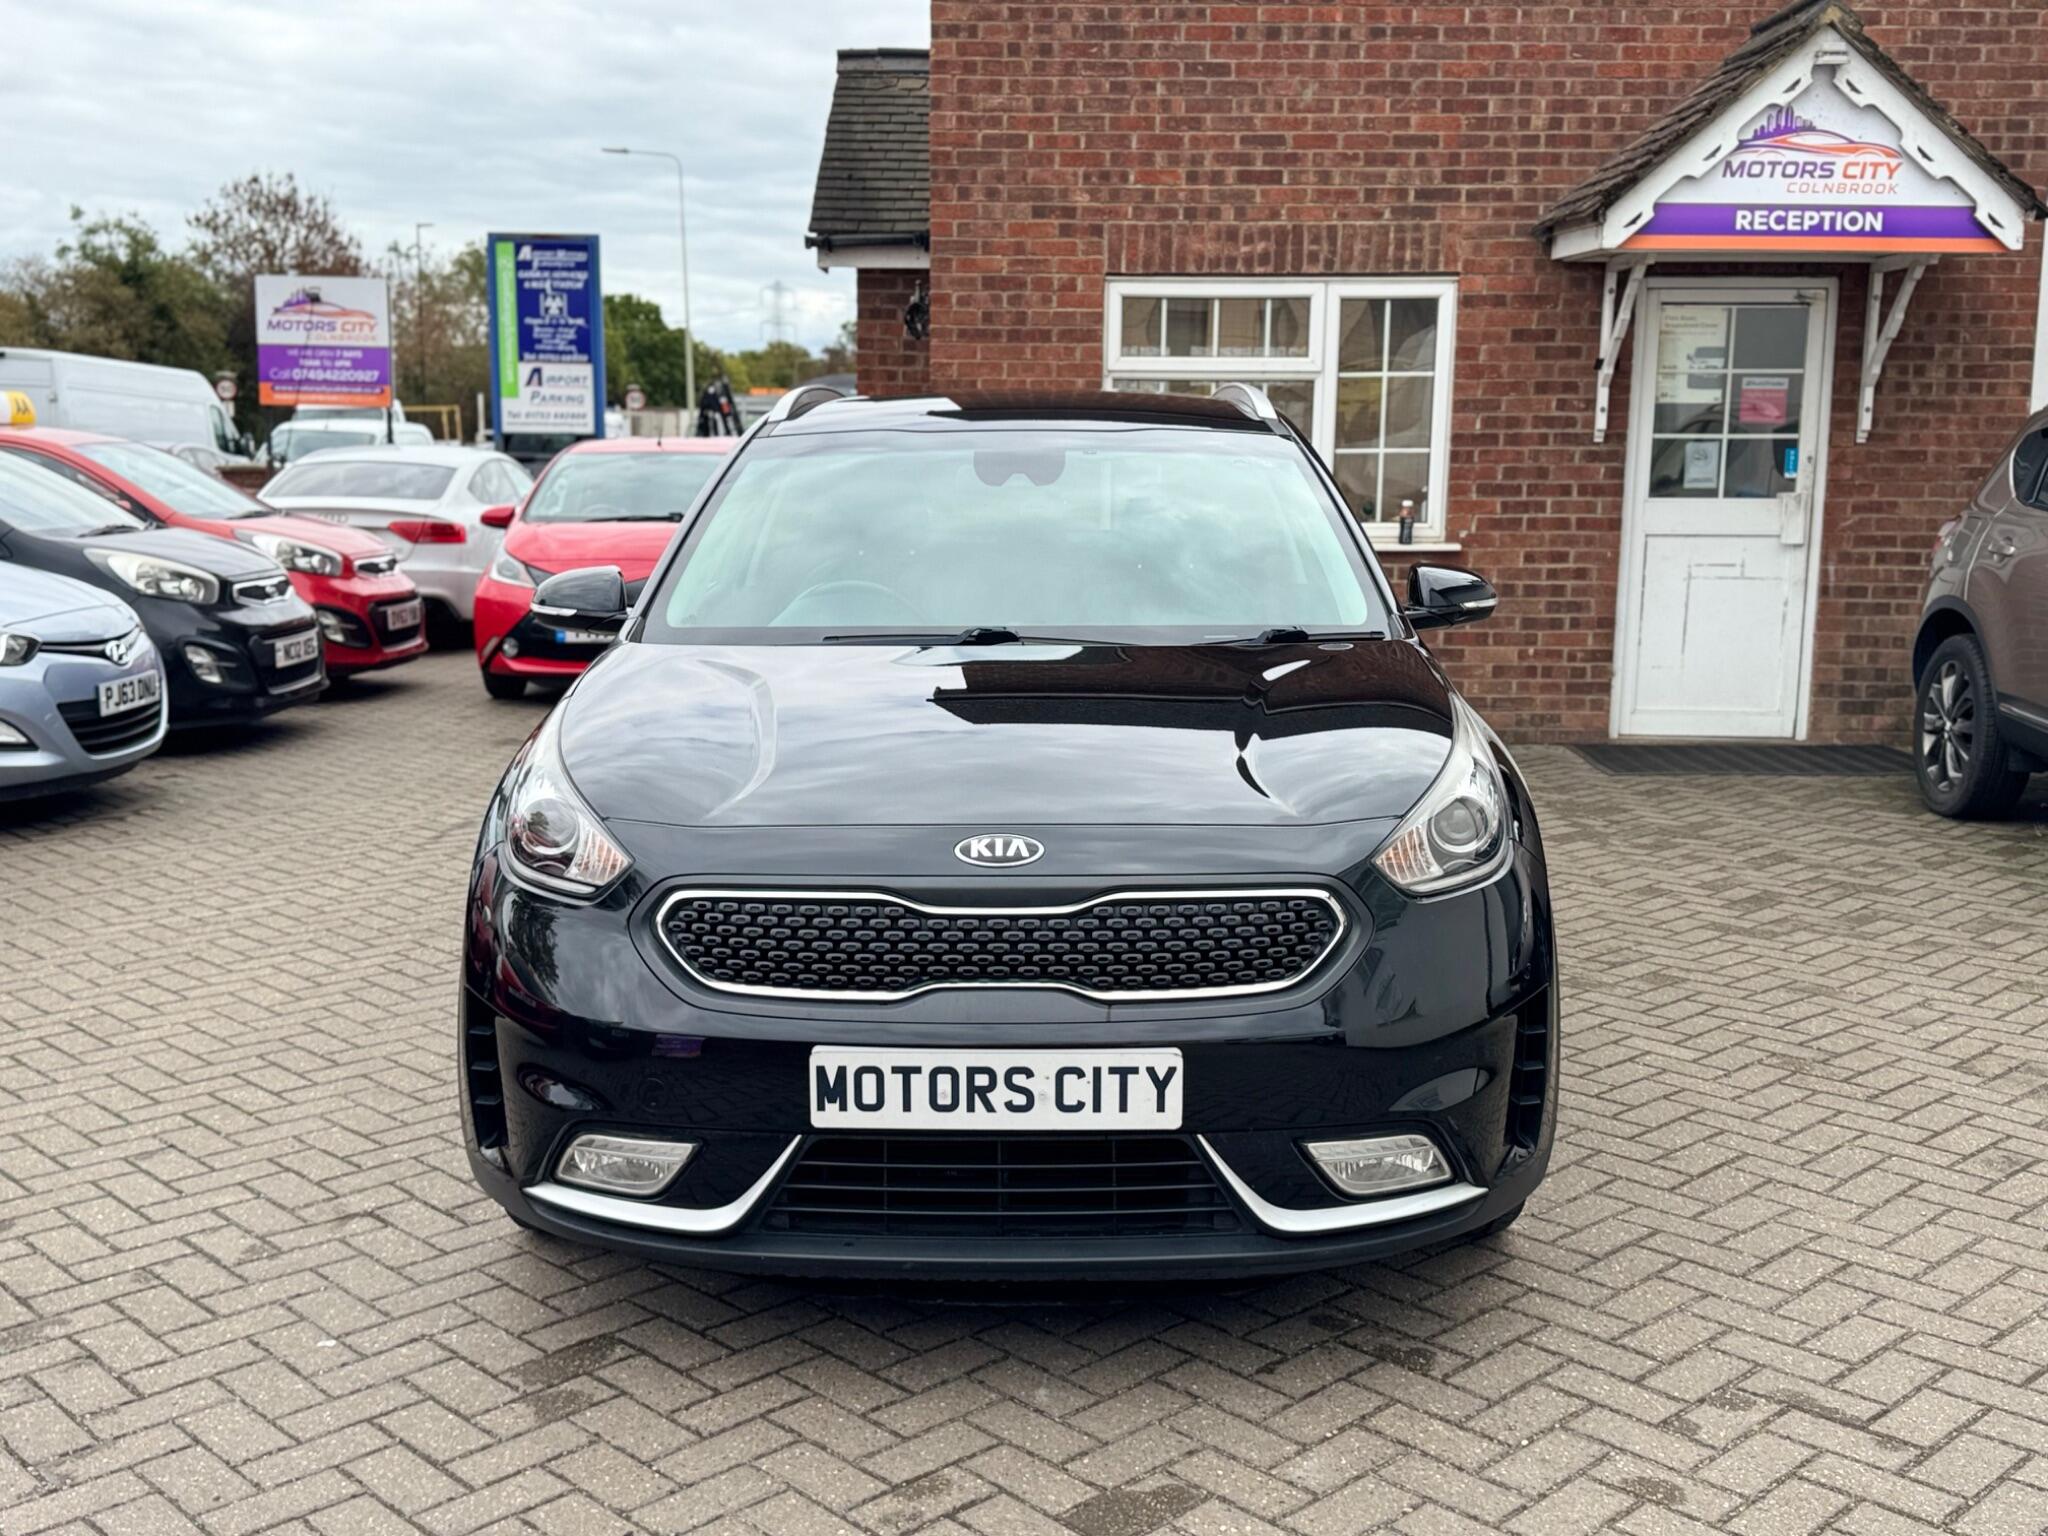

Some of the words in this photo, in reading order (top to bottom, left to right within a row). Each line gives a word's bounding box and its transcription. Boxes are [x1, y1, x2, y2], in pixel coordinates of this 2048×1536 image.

[1722, 161, 1834, 179] MOTORS
[1843, 161, 1902, 180] CITY
[1786, 183, 1898, 194] COLNBROOK
[1735, 210, 1883, 231] RECEPTION
[267, 320, 336, 332] MOTORS
[341, 322, 377, 333] CITY
[269, 368, 290, 380] Call
[525, 367, 588, 387] AIRPORT
[530, 391, 584, 404] PARKING
[105, 681, 135, 708] PJ63
[138, 673, 156, 700] DNU
[970, 838, 1030, 858] KIA
[816, 1065, 1035, 1113] MOTORS
[1055, 1066, 1177, 1113] CITY
